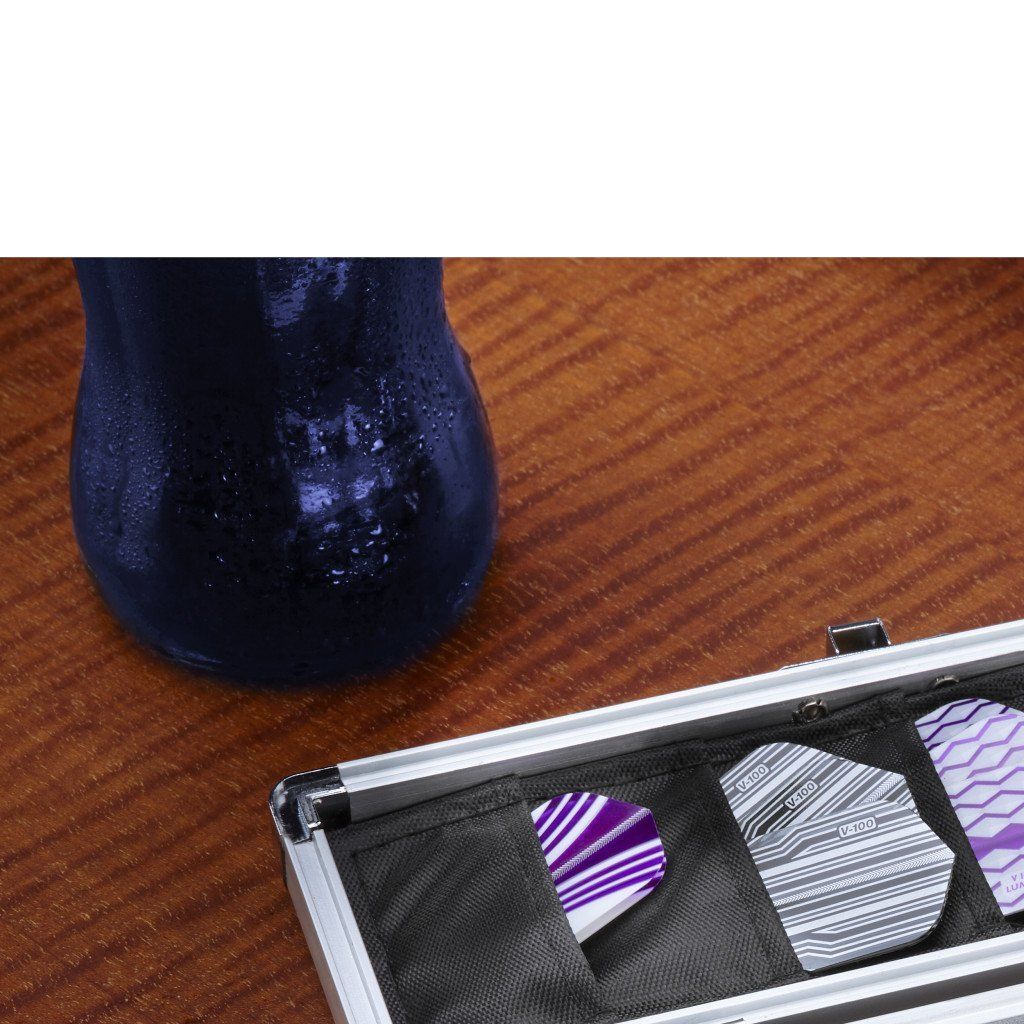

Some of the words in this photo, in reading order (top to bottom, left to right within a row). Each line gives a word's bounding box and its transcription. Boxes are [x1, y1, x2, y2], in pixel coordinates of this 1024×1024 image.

[737, 766, 767, 792] V-100
[786, 782, 816, 808] V-100
[840, 819, 875, 835] V-100
